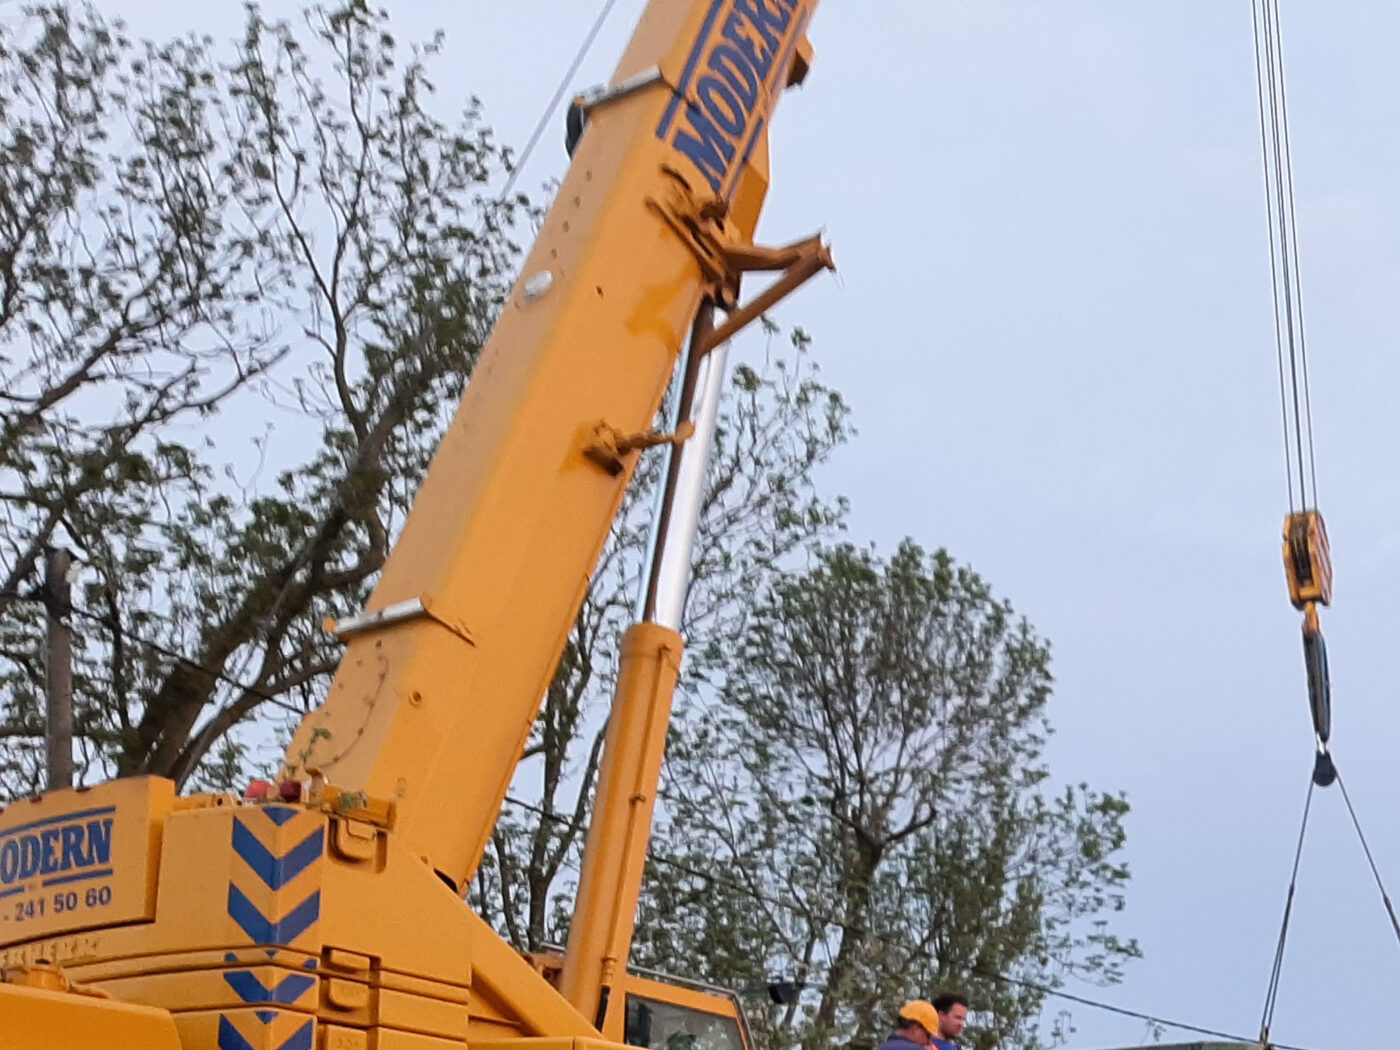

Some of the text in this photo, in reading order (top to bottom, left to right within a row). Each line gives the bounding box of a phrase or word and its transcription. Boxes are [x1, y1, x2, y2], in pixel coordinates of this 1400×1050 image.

[673, 0, 798, 193] MODER
[15, 885, 112, 922] 241 50 60
